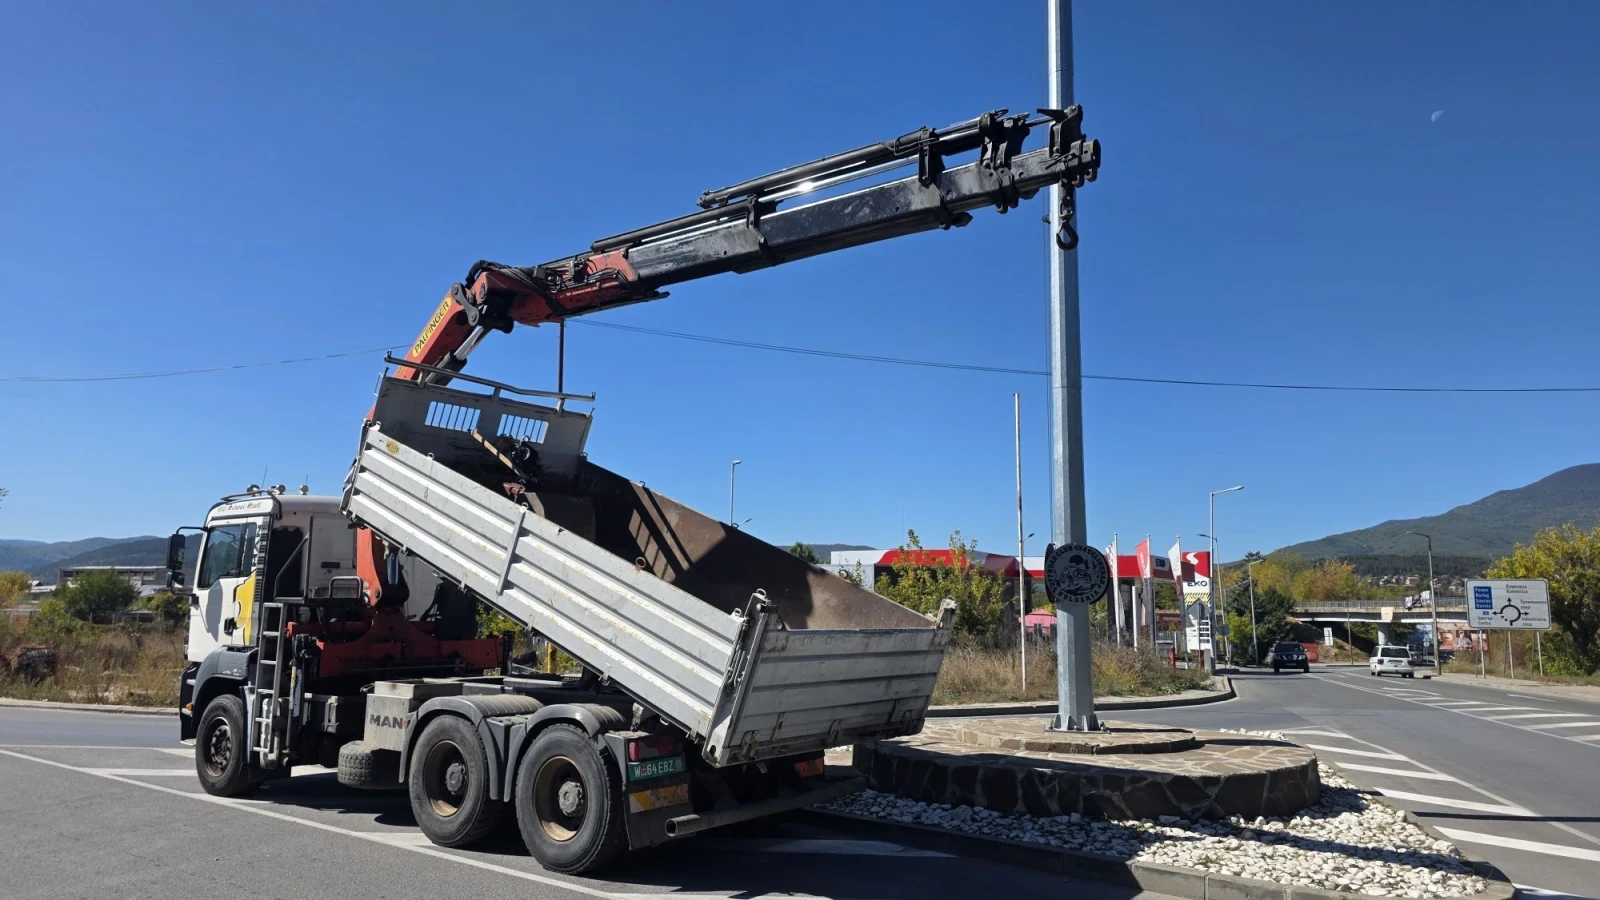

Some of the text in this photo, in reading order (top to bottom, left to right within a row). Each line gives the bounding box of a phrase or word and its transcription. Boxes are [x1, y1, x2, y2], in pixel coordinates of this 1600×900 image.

[414, 300, 450, 354] PALFINGER
[1056, 545, 1073, 557] CLUB
[1087, 549, 1106, 585] VELINGRAD
[1058, 590, 1100, 603] BULGARIA
[370, 714, 403, 729] MAN
